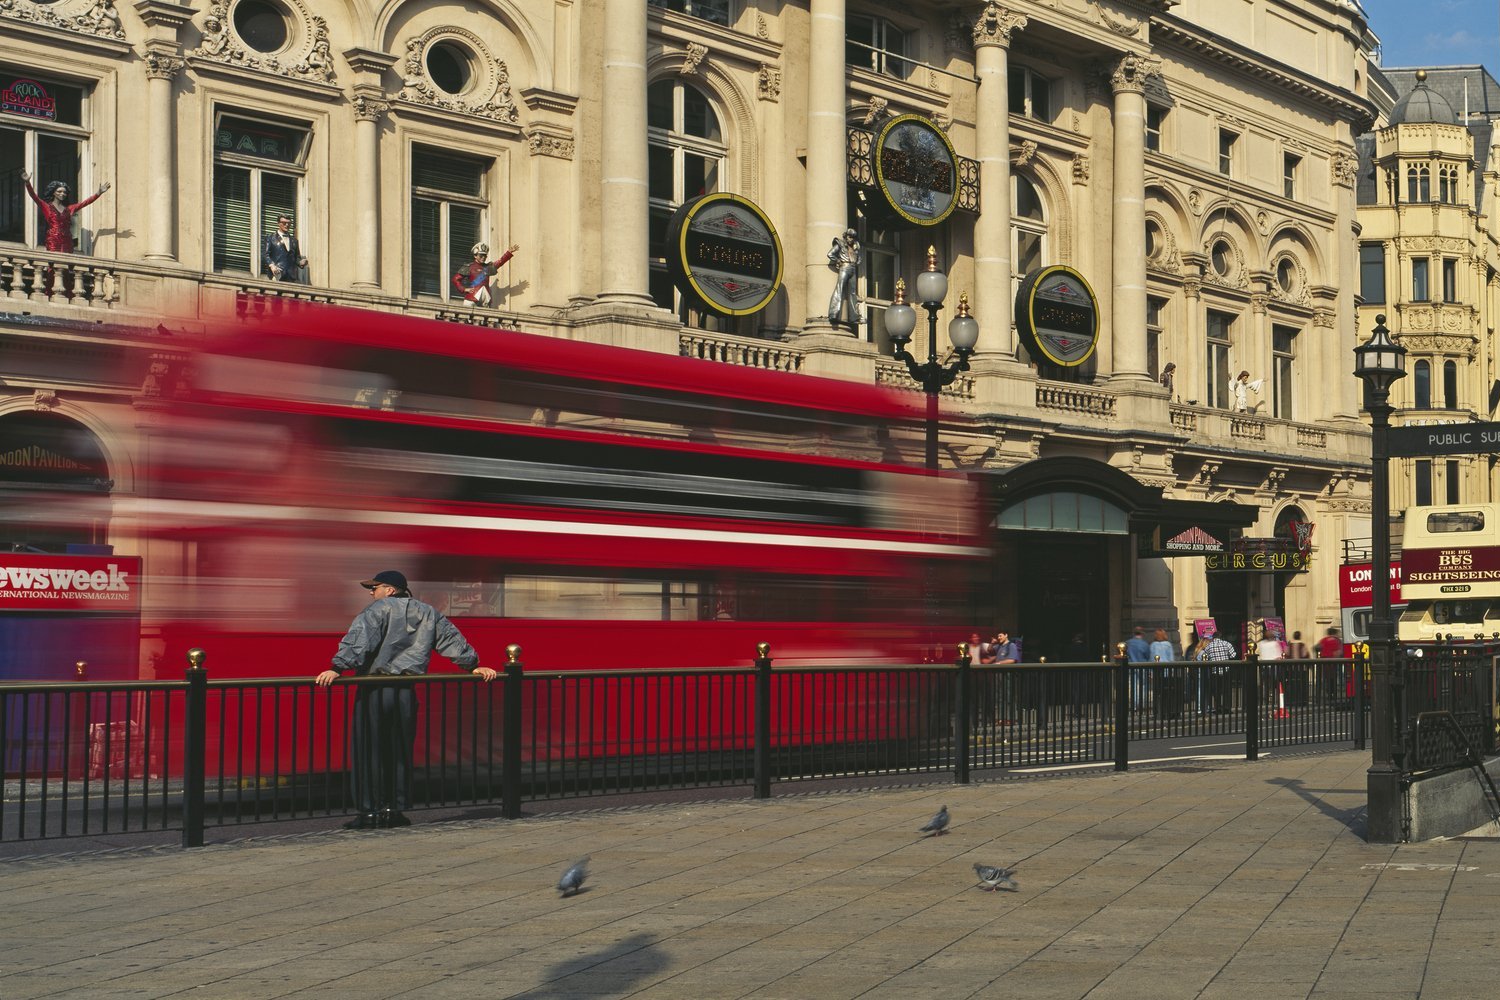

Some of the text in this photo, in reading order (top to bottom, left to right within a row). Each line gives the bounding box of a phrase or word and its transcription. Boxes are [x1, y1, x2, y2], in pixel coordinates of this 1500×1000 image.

[15, 84, 41, 98] ROCK
[5, 91, 51, 108] ISLAND
[2, 103, 54, 118] DINER
[217, 131, 279, 156] BAR
[1429, 433, 1471, 445] PUBLIC
[33, 445, 78, 469] PAVILION
[1206, 552, 1302, 568] CIRCUS
[1439, 555, 1473, 566] BUS
[1350, 568, 1397, 582] LONN
[61, 591, 129, 600] NEWSMAGAZINE
